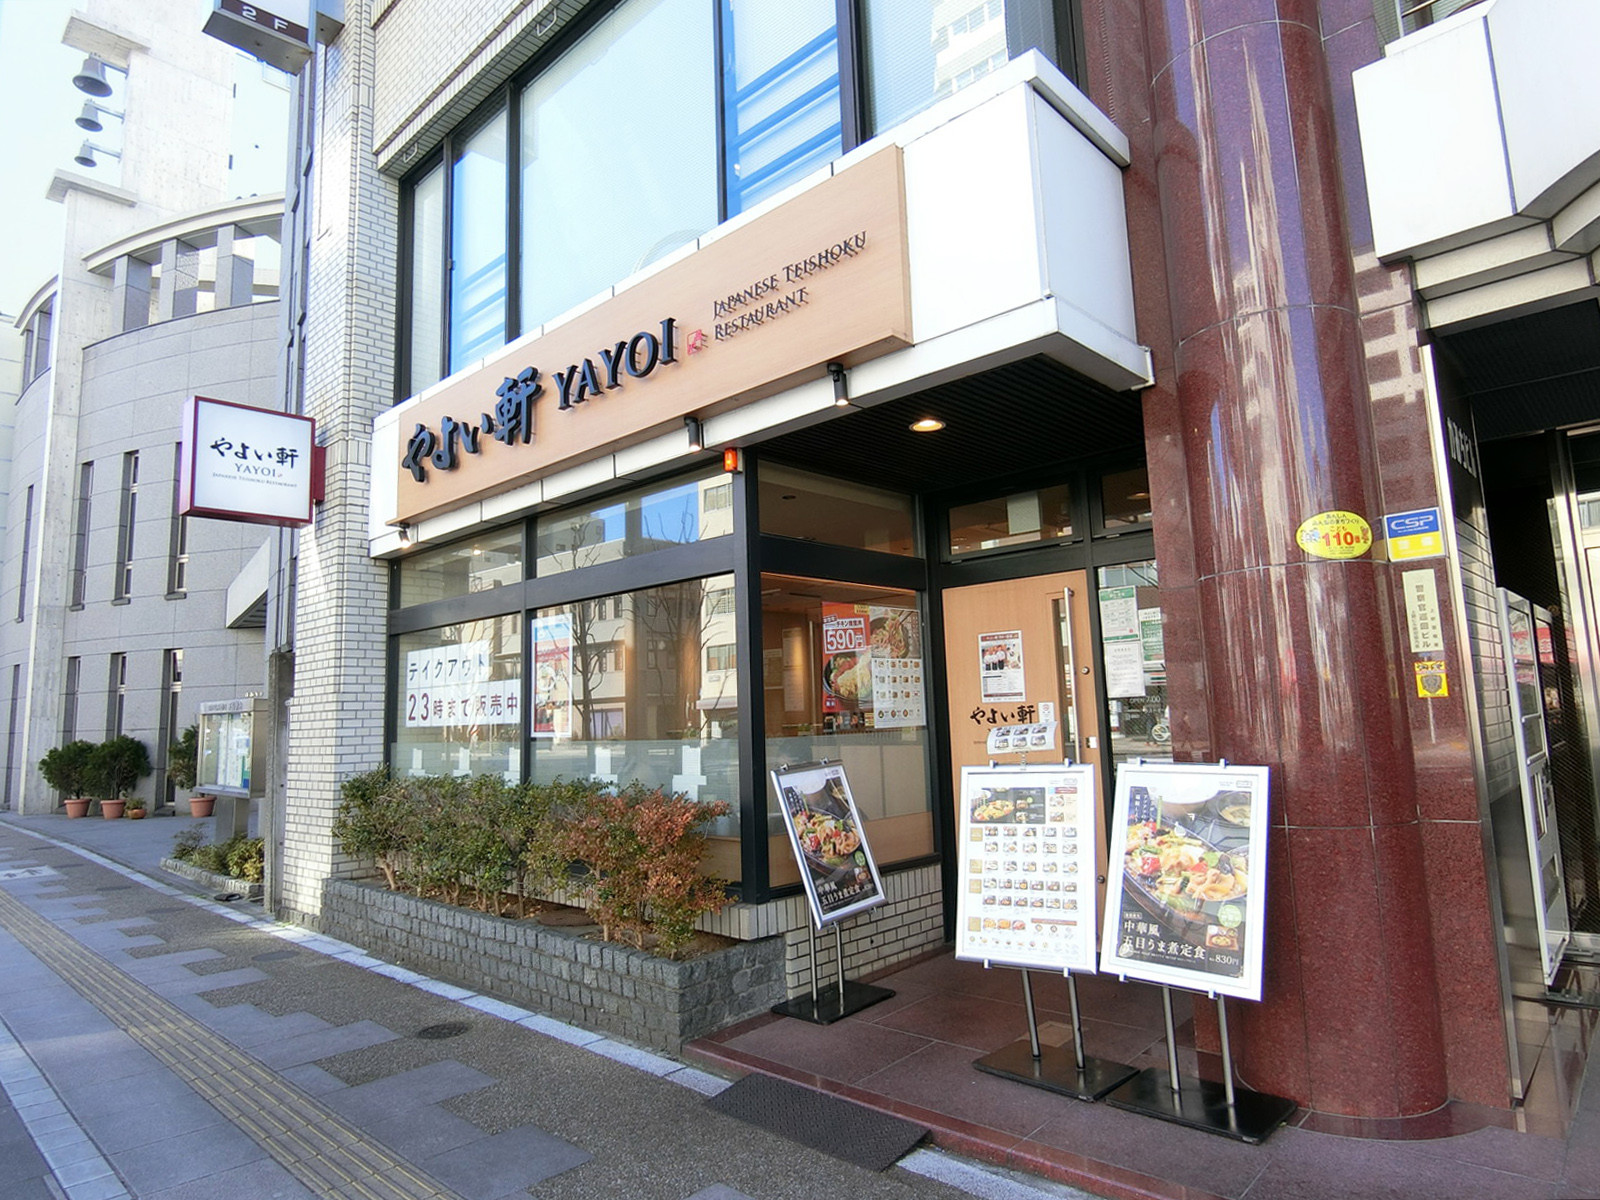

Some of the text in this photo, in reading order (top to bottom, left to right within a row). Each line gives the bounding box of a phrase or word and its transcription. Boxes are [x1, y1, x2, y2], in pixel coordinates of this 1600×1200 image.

[712, 231, 867, 321] JAPANESE TEISHOKU
[713, 287, 808, 341] RESTAURANT
[402, 317, 677, 483] やよい軒 YAYOI
[210, 437, 299, 469] やよい軒
[234, 463, 277, 478] YAYOI
[1390, 515, 1434, 530] CSP
[408, 652, 487, 682] テイクアウト
[407, 691, 519, 722] 23時まで販売中
[970, 705, 1036, 725] やよい軒
[1123, 919, 1160, 937] 中華風
[1122, 934, 1207, 960] 五目うま煮定食
